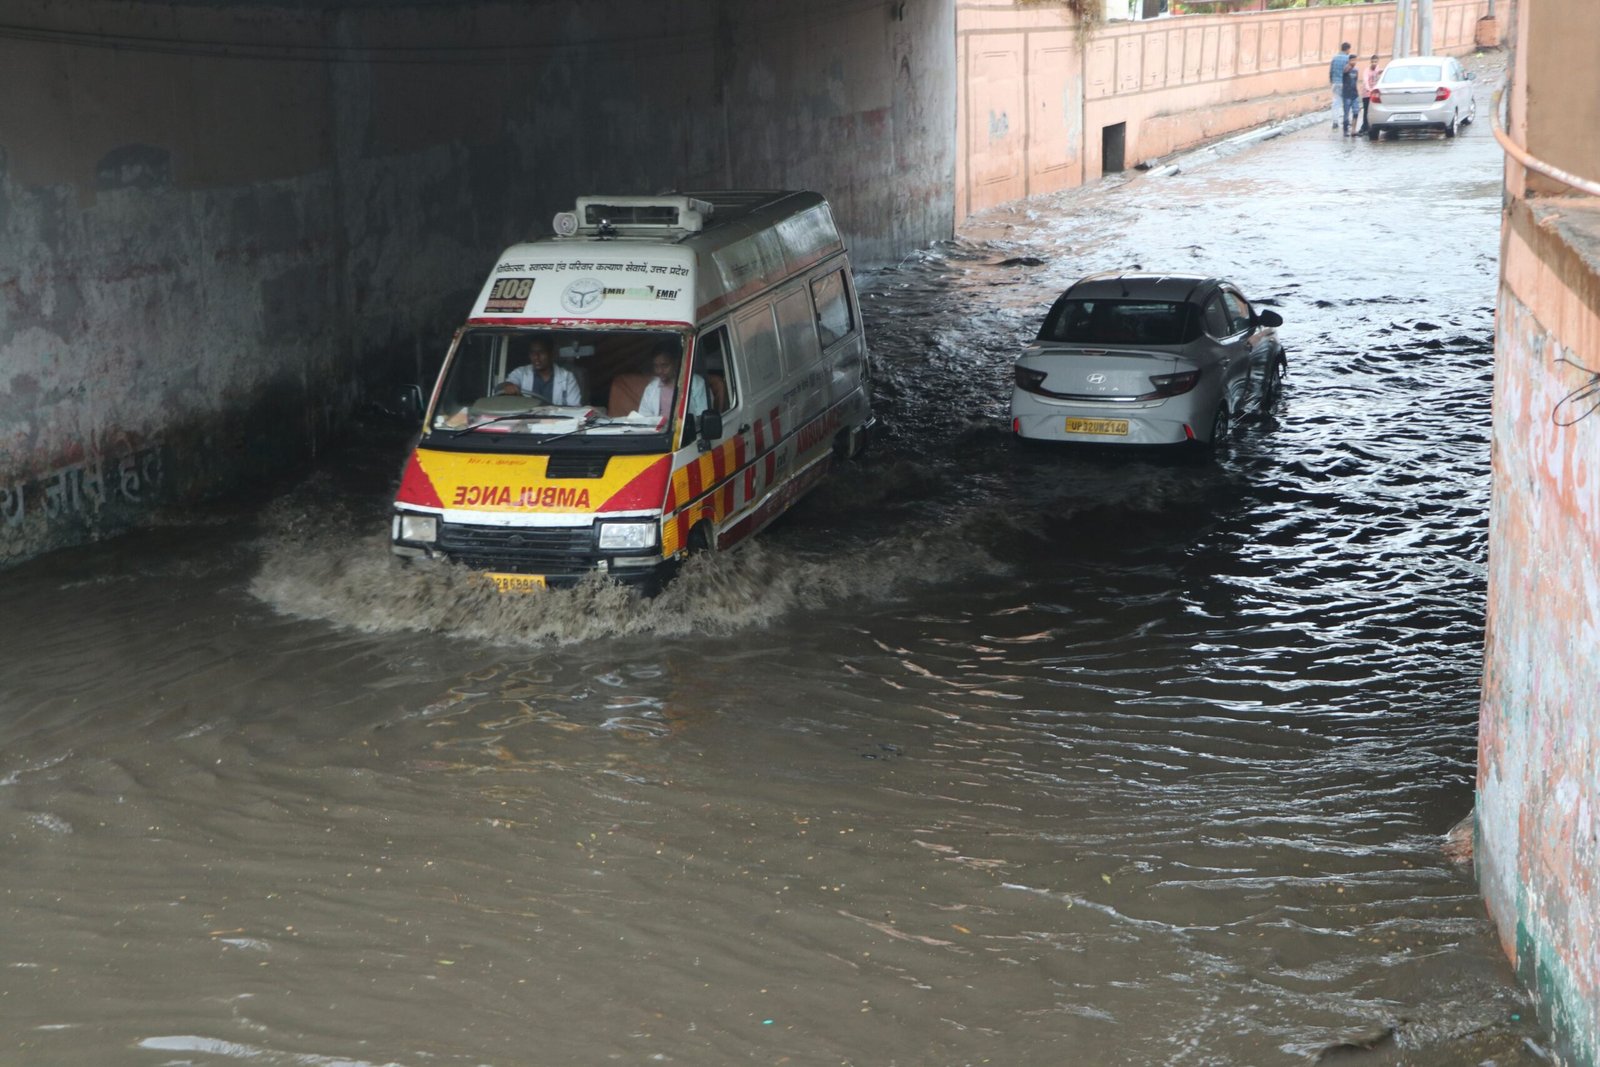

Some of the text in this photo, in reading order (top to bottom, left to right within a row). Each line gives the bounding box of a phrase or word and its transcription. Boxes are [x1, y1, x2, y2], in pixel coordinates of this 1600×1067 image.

[569, 260, 594, 271] परिवार
[596, 262, 624, 272] कल्याण
[650, 265, 667, 275] उत्तर
[669, 264, 690, 277] प्रदेश
[496, 279, 533, 299] 108
[602, 287, 625, 295] EMRI
[656, 289, 678, 298] EMRI
